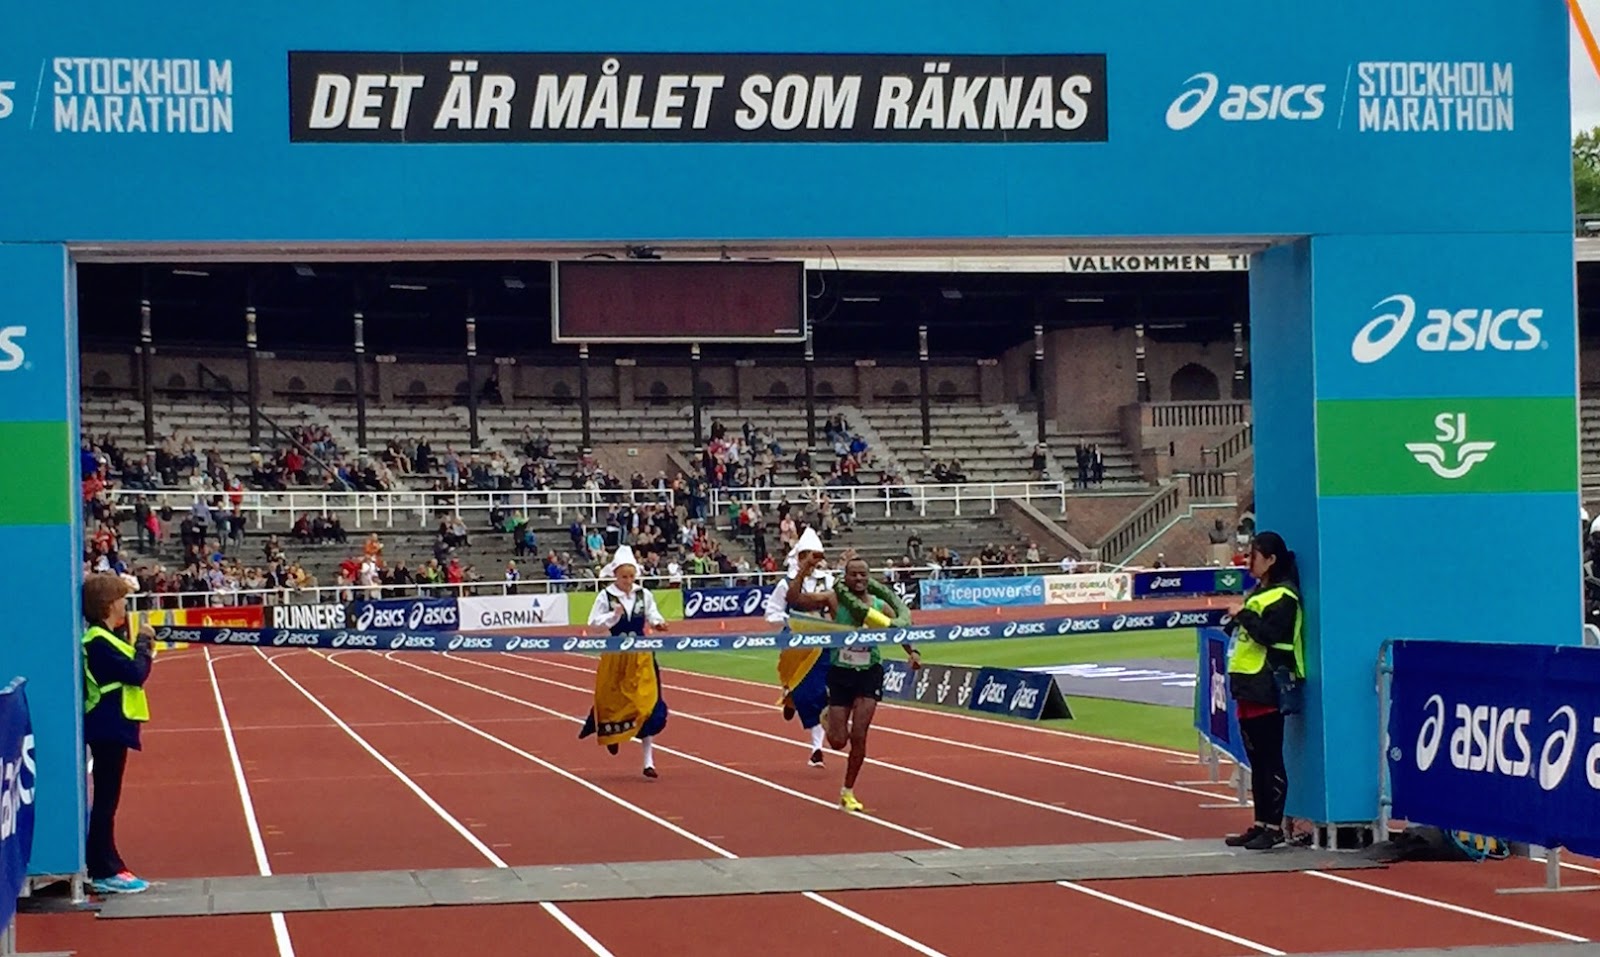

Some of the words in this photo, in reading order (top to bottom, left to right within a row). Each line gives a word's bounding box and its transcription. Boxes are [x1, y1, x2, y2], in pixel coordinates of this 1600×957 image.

[54, 58, 233, 95] STOCKHOLM
[1358, 61, 1514, 97] STOCKHOLM
[308, 74, 425, 130] DET
[433, 60, 517, 130] ÄR
[530, 58, 725, 130] MÅLET
[734, 74, 862, 131] SOM
[873, 62, 1093, 131] RÄKNAS
[54, 96, 233, 133] MARATHON
[1359, 98, 1514, 132] MARATHON
[1434, 412, 1467, 445] SJ
[951, 583, 1042, 602] icepower.se
[273, 603, 346, 630] RUNNERS
[480, 609, 544, 627] GARMIN
